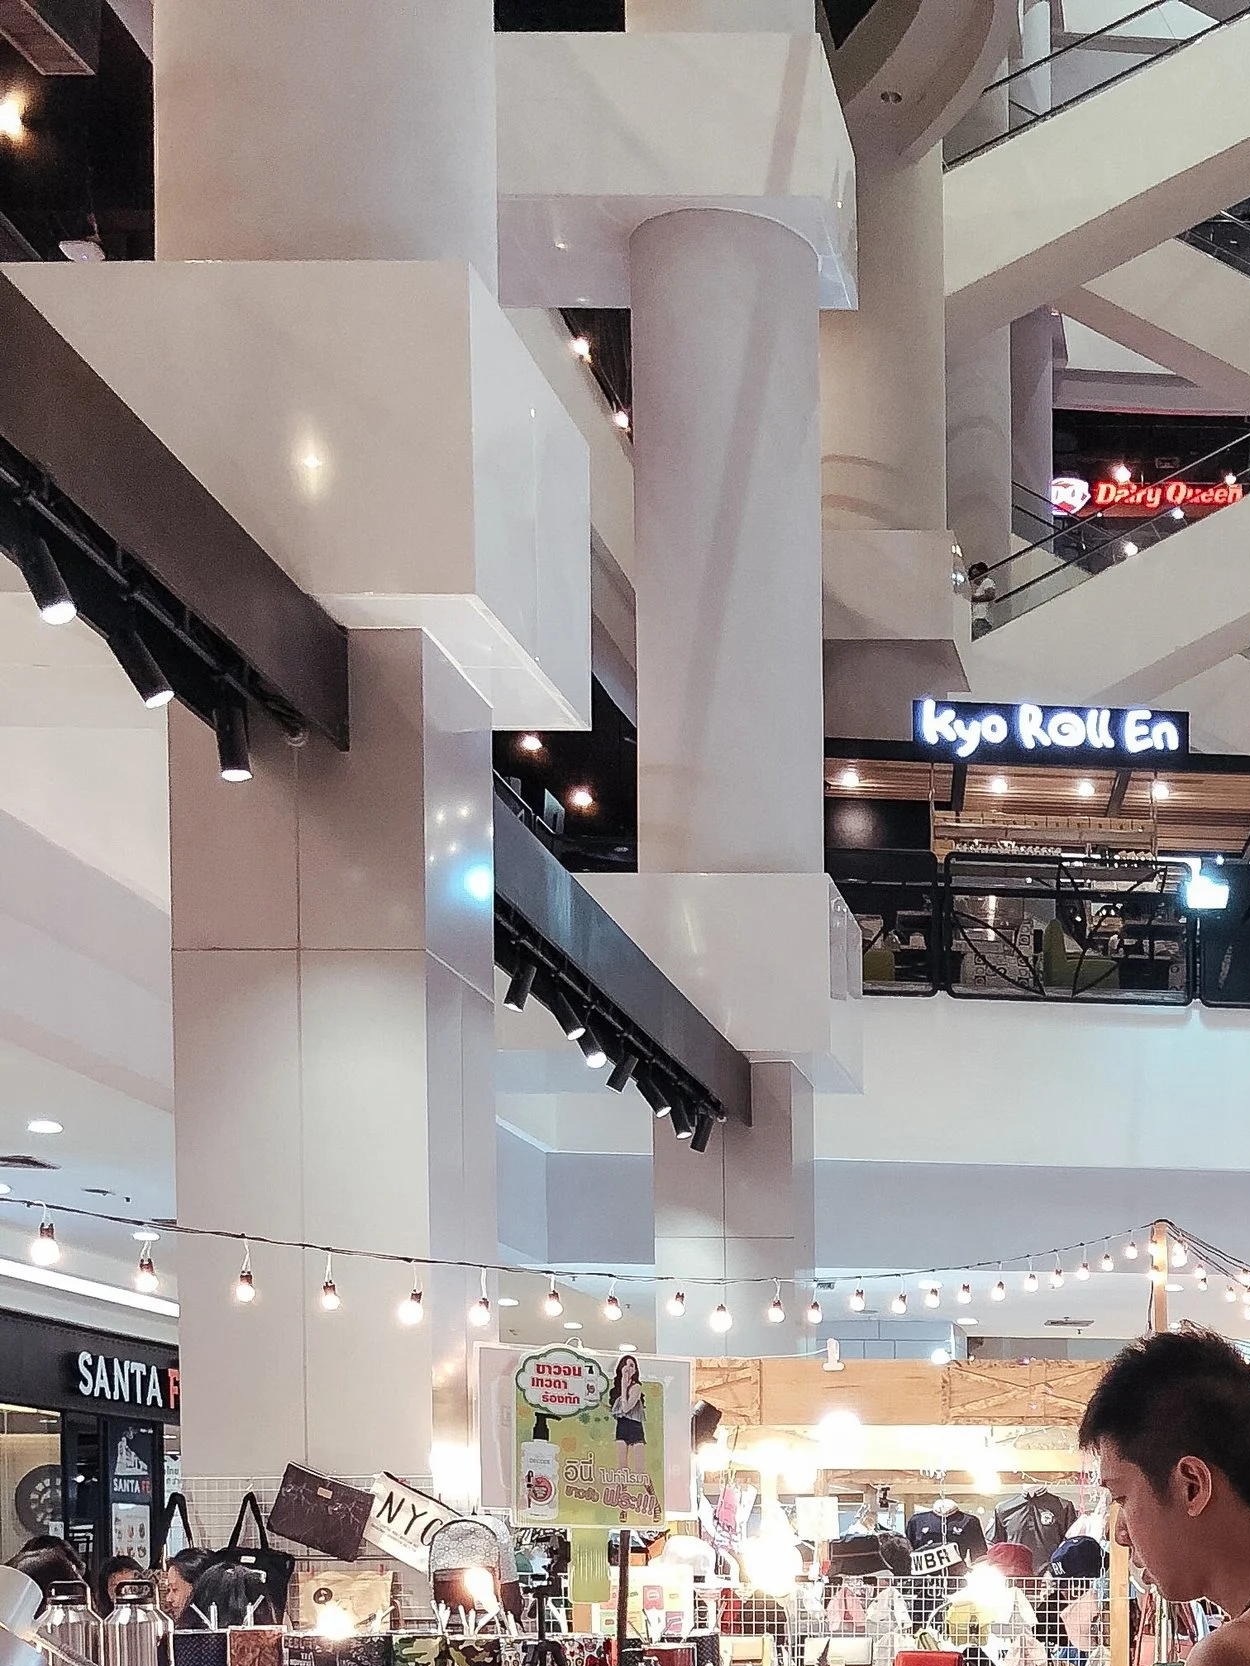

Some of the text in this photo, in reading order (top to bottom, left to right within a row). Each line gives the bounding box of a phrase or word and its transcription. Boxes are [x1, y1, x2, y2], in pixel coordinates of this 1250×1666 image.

[1095, 481, 1244, 508] Dairy Queen
[1018, 703, 1115, 750] Roll
[1124, 709, 1179, 754] En
[78, 1351, 163, 1407] SANTA
[113, 1478, 140, 1493] SANTA
